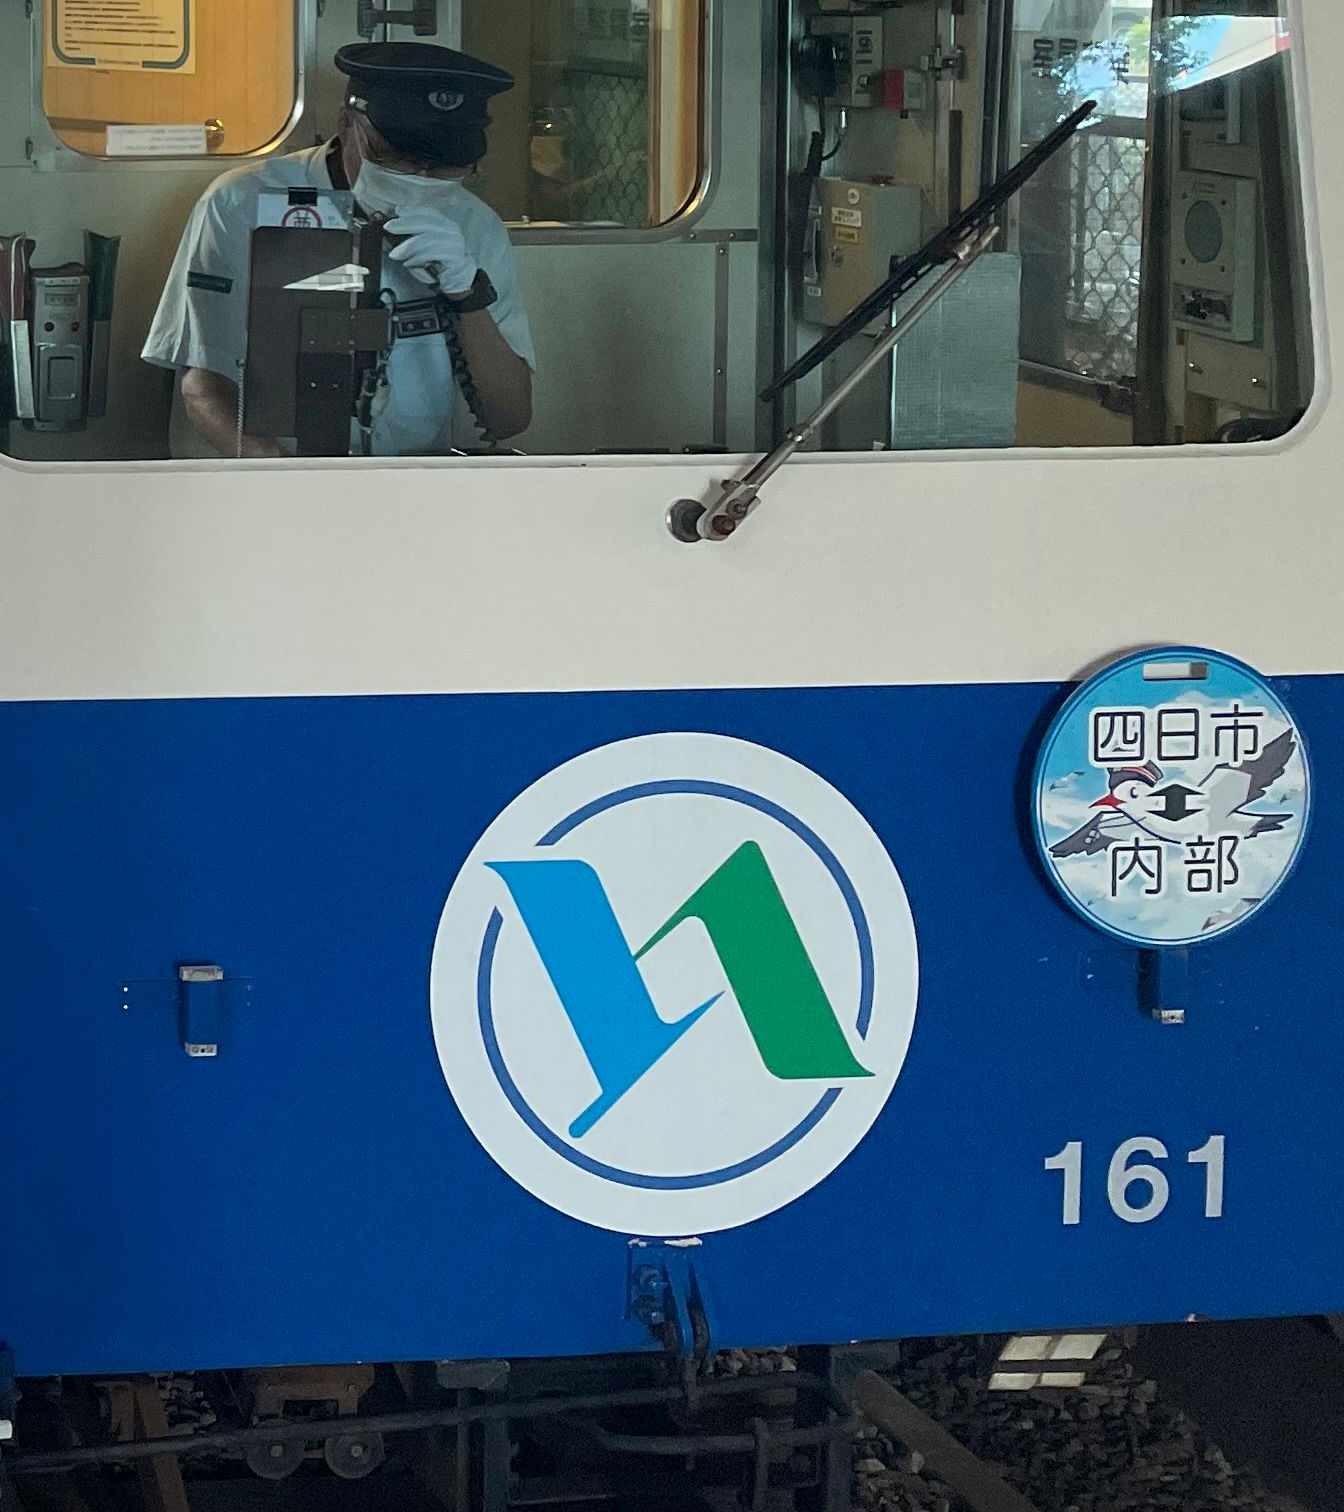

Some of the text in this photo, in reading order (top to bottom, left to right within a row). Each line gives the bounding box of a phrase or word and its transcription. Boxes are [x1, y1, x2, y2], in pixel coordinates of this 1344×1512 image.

[1094, 704, 1264, 762] 四日市
[1112, 834, 1241, 897] 内部
[1044, 1135, 1226, 1225] 161
